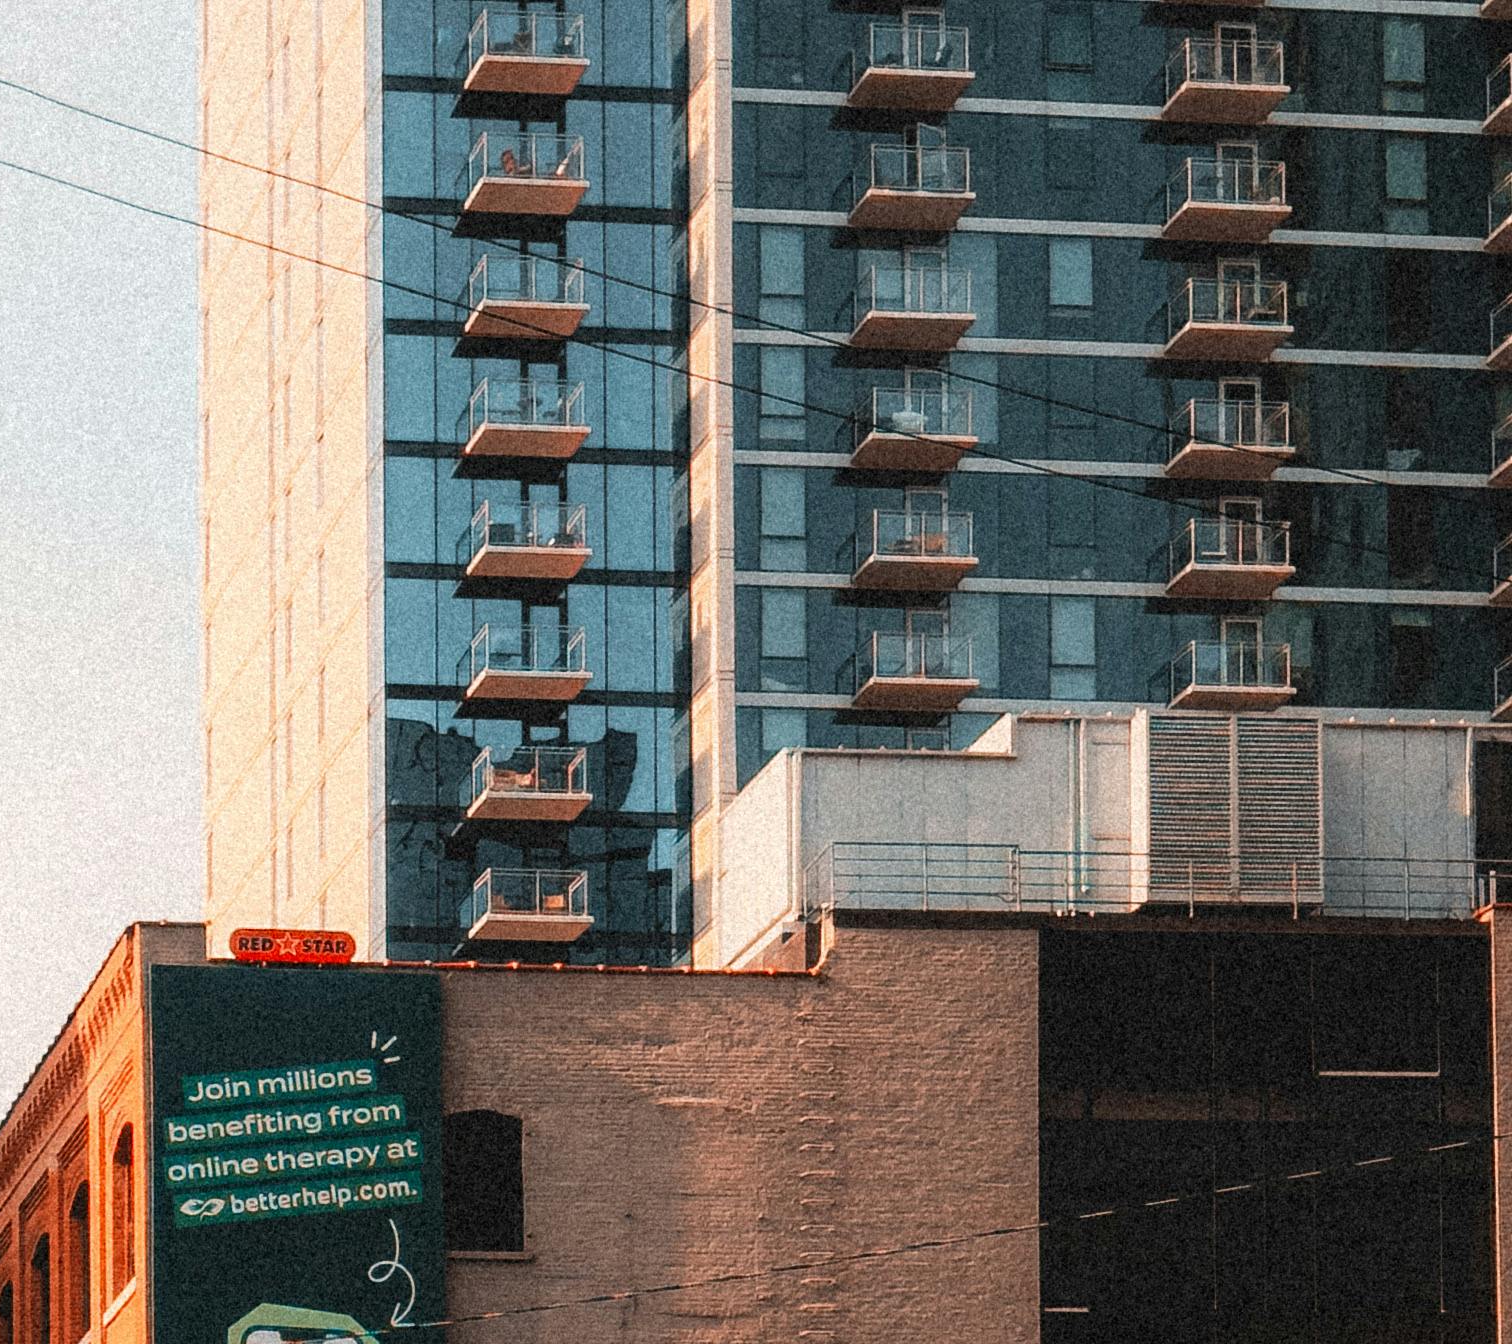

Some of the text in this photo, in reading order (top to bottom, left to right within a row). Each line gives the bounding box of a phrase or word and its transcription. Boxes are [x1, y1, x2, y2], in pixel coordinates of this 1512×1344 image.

[238, 936, 348, 955] RED STAR
[188, 1065, 373, 1103] Join millions
[168, 1101, 401, 1143] benefiting from
[167, 1137, 420, 1182] online therapy at
[230, 1178, 418, 1215] betterhelp.com.
